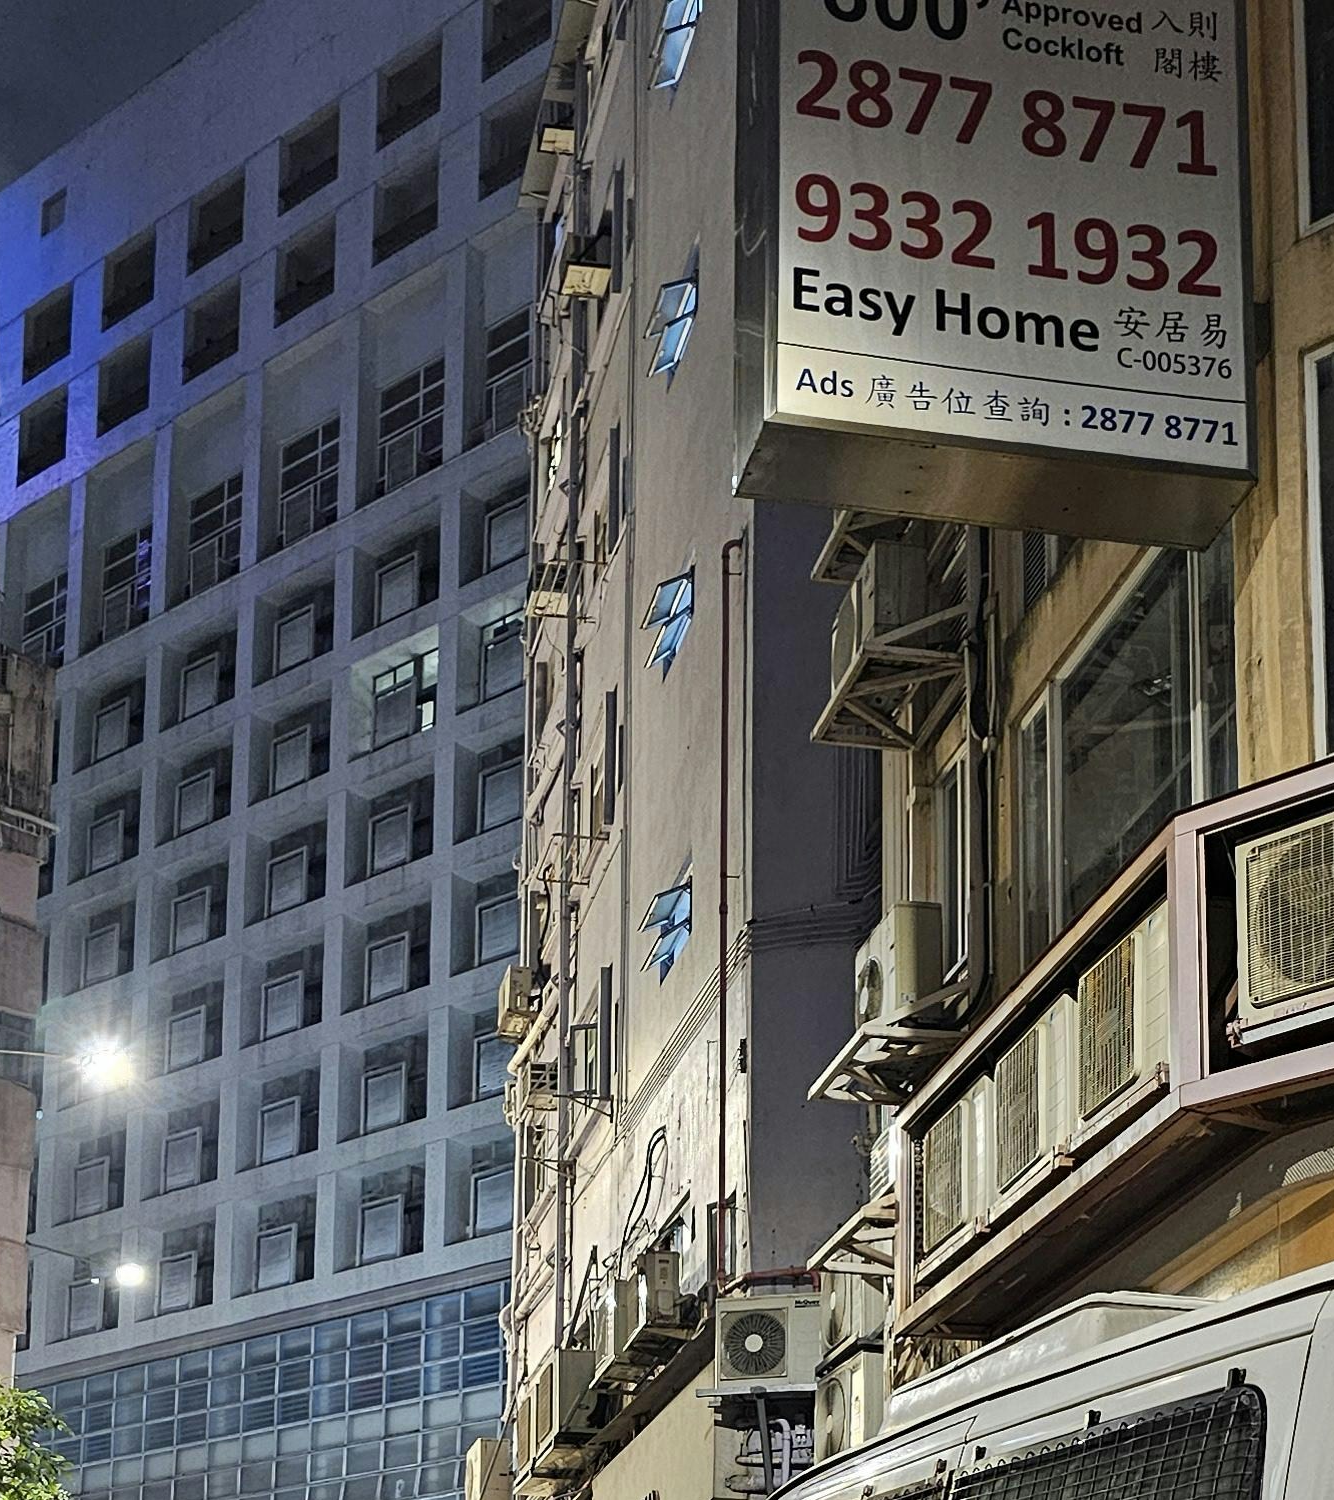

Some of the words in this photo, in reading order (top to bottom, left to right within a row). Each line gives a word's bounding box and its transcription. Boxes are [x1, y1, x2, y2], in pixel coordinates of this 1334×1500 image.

[1002, 0, 1142, 34] Approved
[1151, 11, 1218, 41] 入則
[1002, 28, 1124, 66] Cockloft
[1155, 48, 1223, 83] 閣樓
[796, 50, 993, 145] 2877
[1021, 90, 1218, 176] 8771
[794, 173, 996, 270] 9332
[1026, 212, 1222, 298] 1932
[792, 267, 912, 336] Easy
[935, 289, 1099, 352] Home
[1114, 306, 1227, 349] 安居易
[1116, 348, 1232, 380] C-005376
[795, 367, 854, 398] Ads
[1081, 405, 1156, 437] 2877
[1164, 416, 1239, 446] 8771
